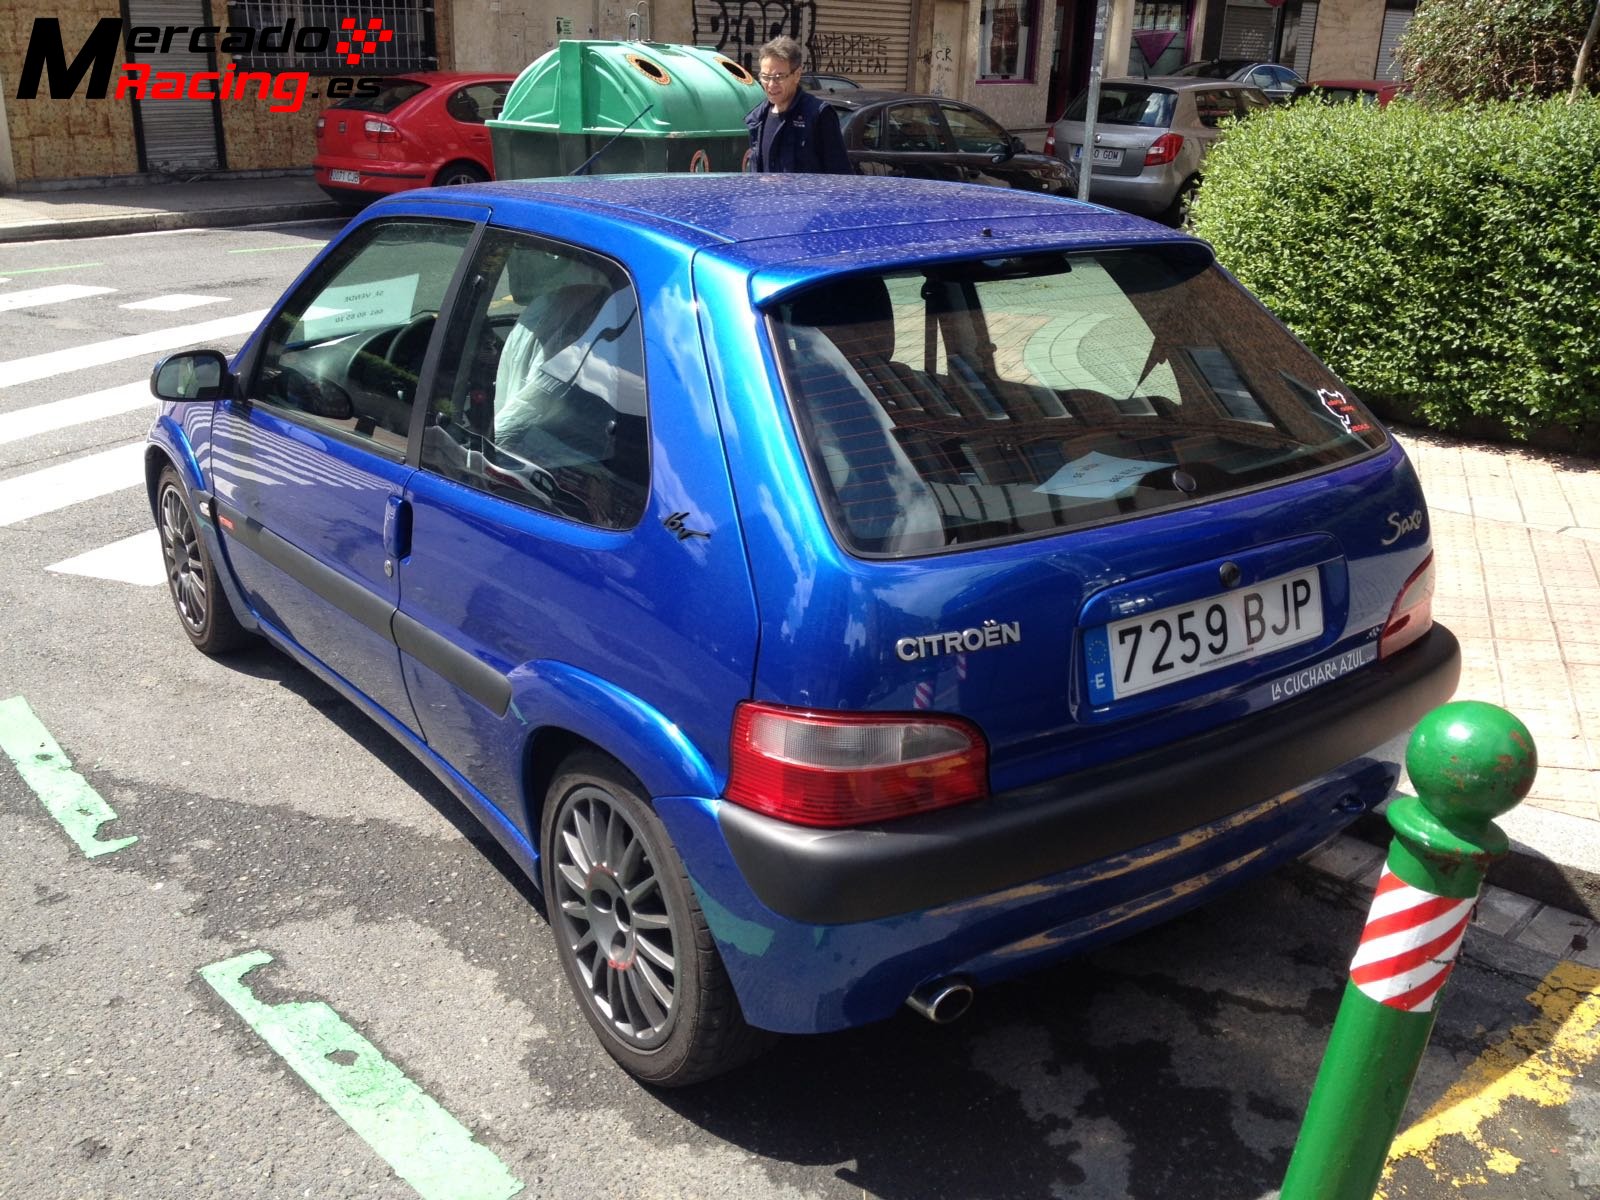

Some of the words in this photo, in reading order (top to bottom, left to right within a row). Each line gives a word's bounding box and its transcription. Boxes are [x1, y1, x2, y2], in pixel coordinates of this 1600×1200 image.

[826, 57, 888, 75] ANTIFA!
[1381, 509, 1423, 546] Saxo
[896, 619, 1022, 662] CITROËN
[1118, 603, 1229, 684] 7259
[1243, 578, 1312, 647] BJP
[1094, 672, 1107, 690] E
[1283, 661, 1338, 697] CUCHARA
